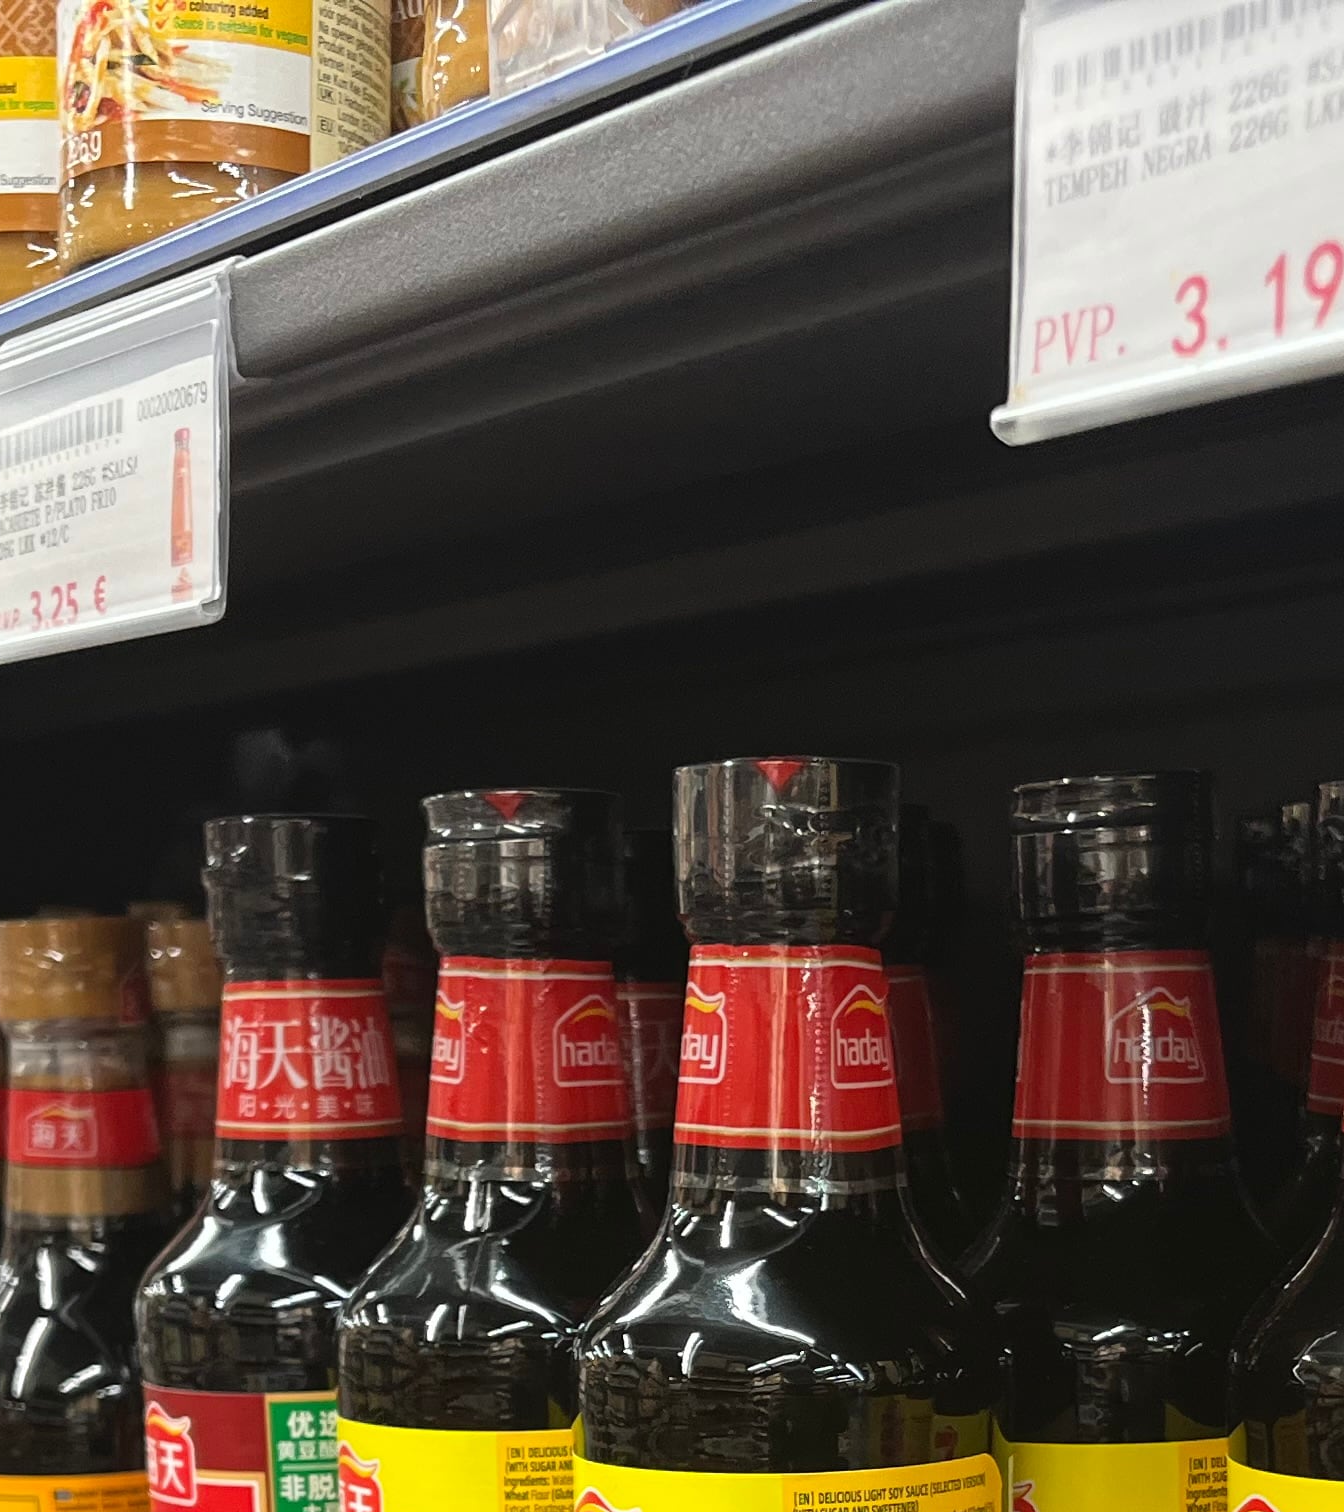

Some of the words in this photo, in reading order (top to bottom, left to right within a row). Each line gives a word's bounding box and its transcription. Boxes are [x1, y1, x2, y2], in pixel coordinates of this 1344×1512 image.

[201, 99, 245, 119] Serving
[247, 103, 307, 126] Suggestion
[1228, 66, 1288, 113] 226G
[1044, 158, 1128, 206] TEMPEH
[1141, 133, 1212, 182] NEGRA
[1228, 107, 1288, 153] 226G
[1031, 304, 1126, 375] PVP.
[31, 582, 79, 631] 3.25
[94, 575, 107, 614] €
[223, 1016, 392, 1091] 海天酱油
[818, 1489, 862, 1505] DELICIOUS
[864, 1487, 887, 1503] LIGHT
[888, 1486, 904, 1501] SOY
[905, 1483, 929, 1499] SAUCE
